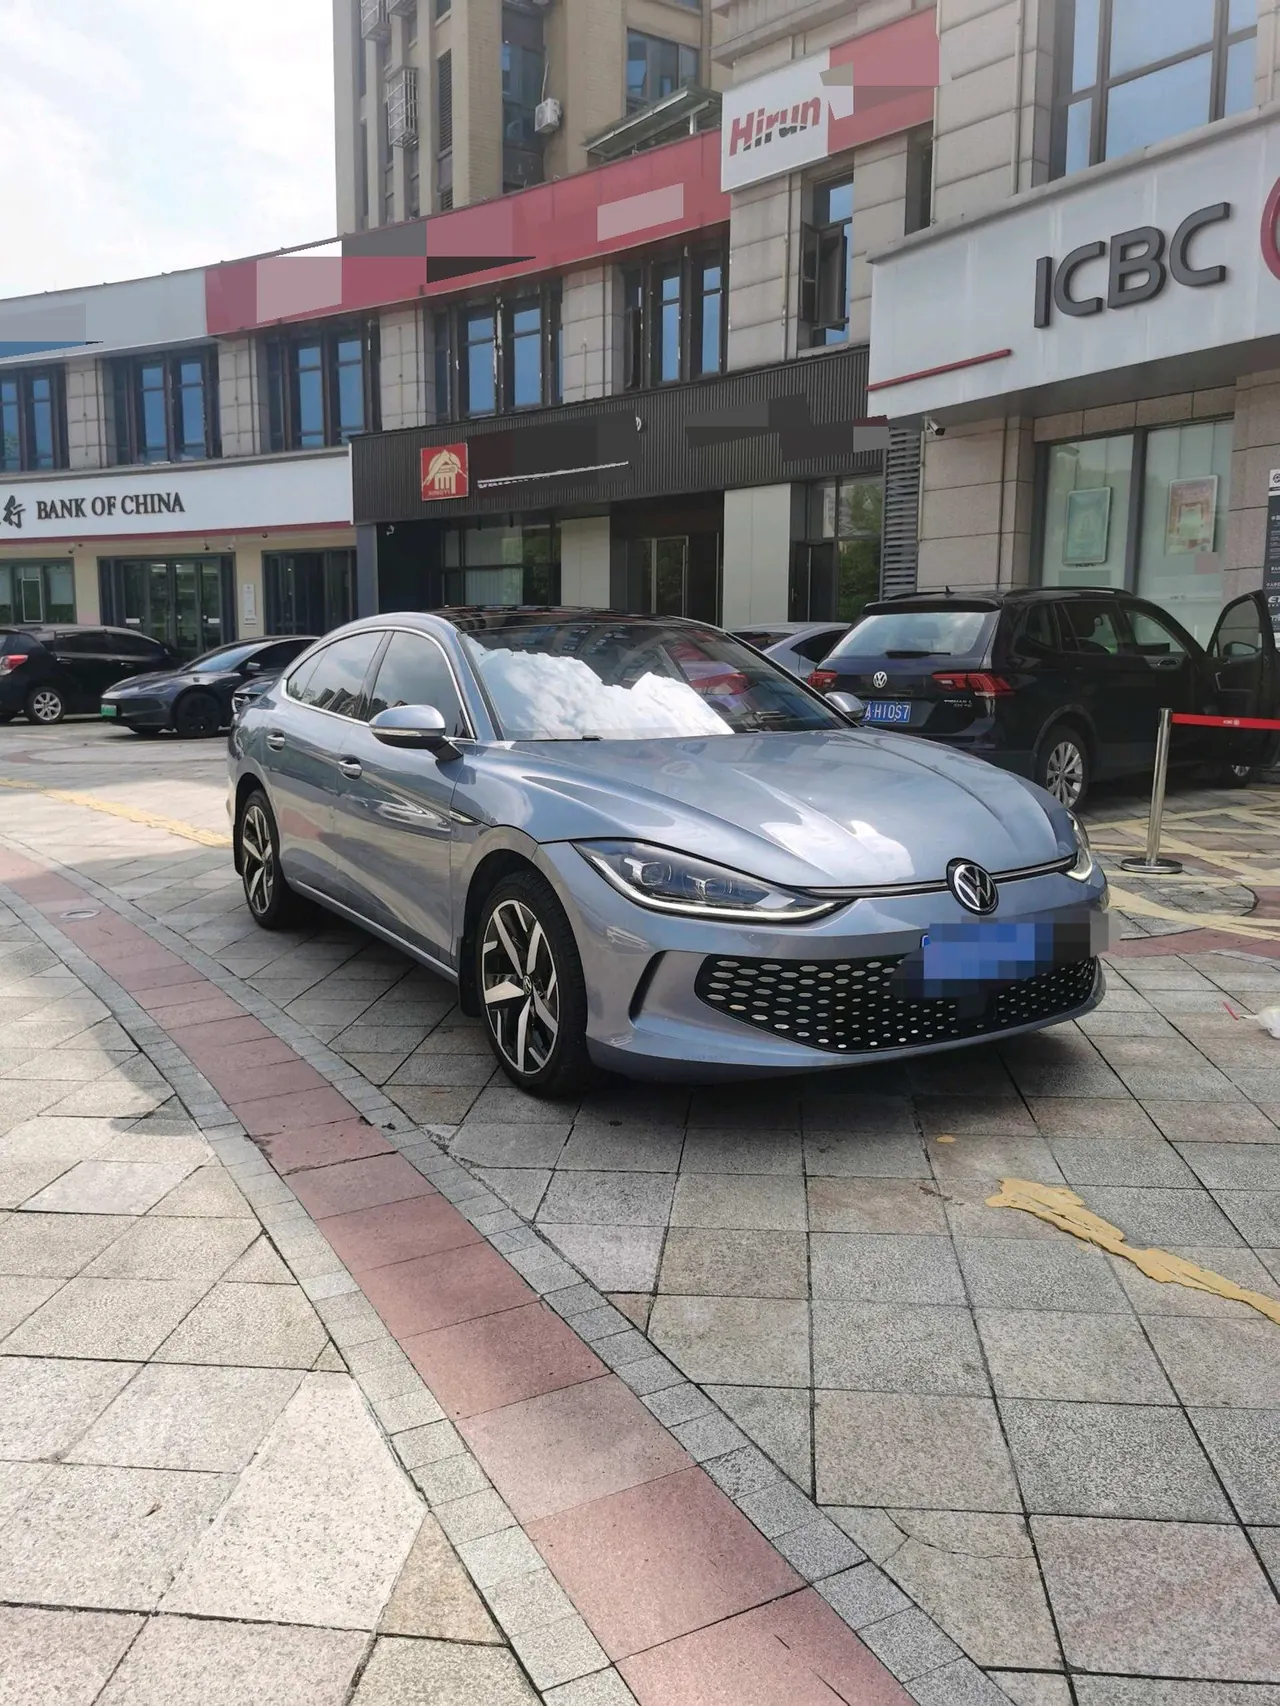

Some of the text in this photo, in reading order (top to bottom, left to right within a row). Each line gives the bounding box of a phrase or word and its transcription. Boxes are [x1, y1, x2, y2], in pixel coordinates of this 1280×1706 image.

[728, 96, 821, 157] Hirun
[1034, 202, 1231, 329] ICBC
[0, 495, 26, 528] 行
[36, 492, 185, 520] BANK OF CHINA
